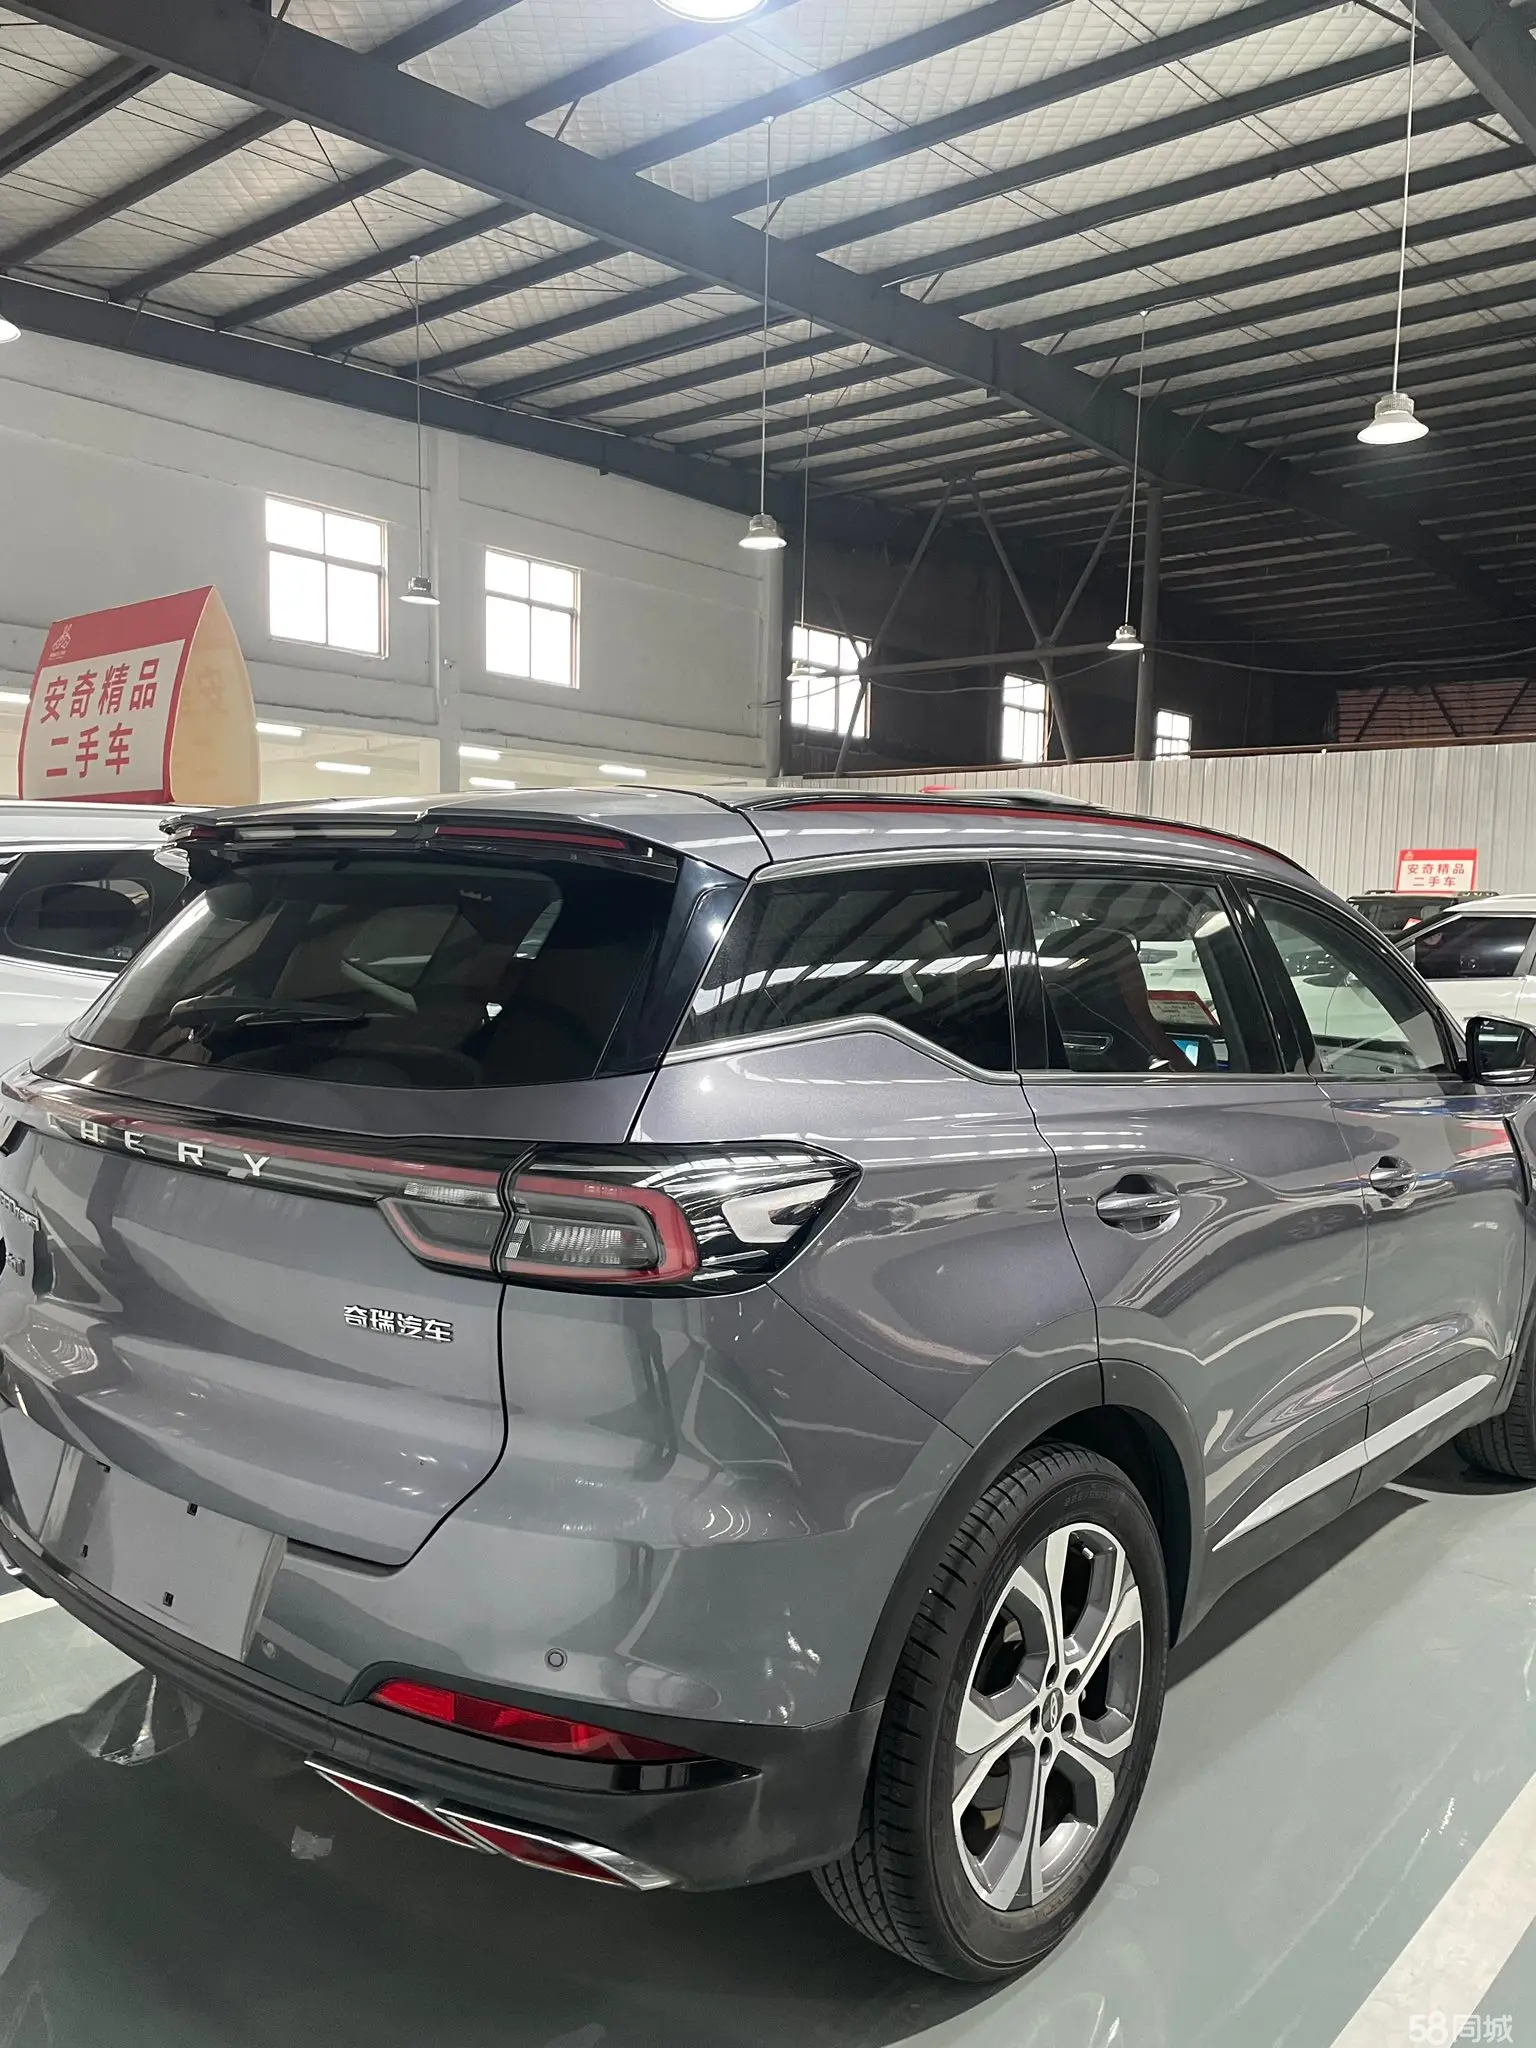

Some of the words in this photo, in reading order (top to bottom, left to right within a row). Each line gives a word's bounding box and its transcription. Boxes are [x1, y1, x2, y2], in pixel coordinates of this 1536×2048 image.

[40, 657, 160, 724] 安奇精品
[46, 722, 133, 778] 二手车
[1407, 863, 1465, 875] 安奇精品
[1413, 876, 1456, 888] 二手车
[343, 1305, 452, 1342] 奇瑞汽车
